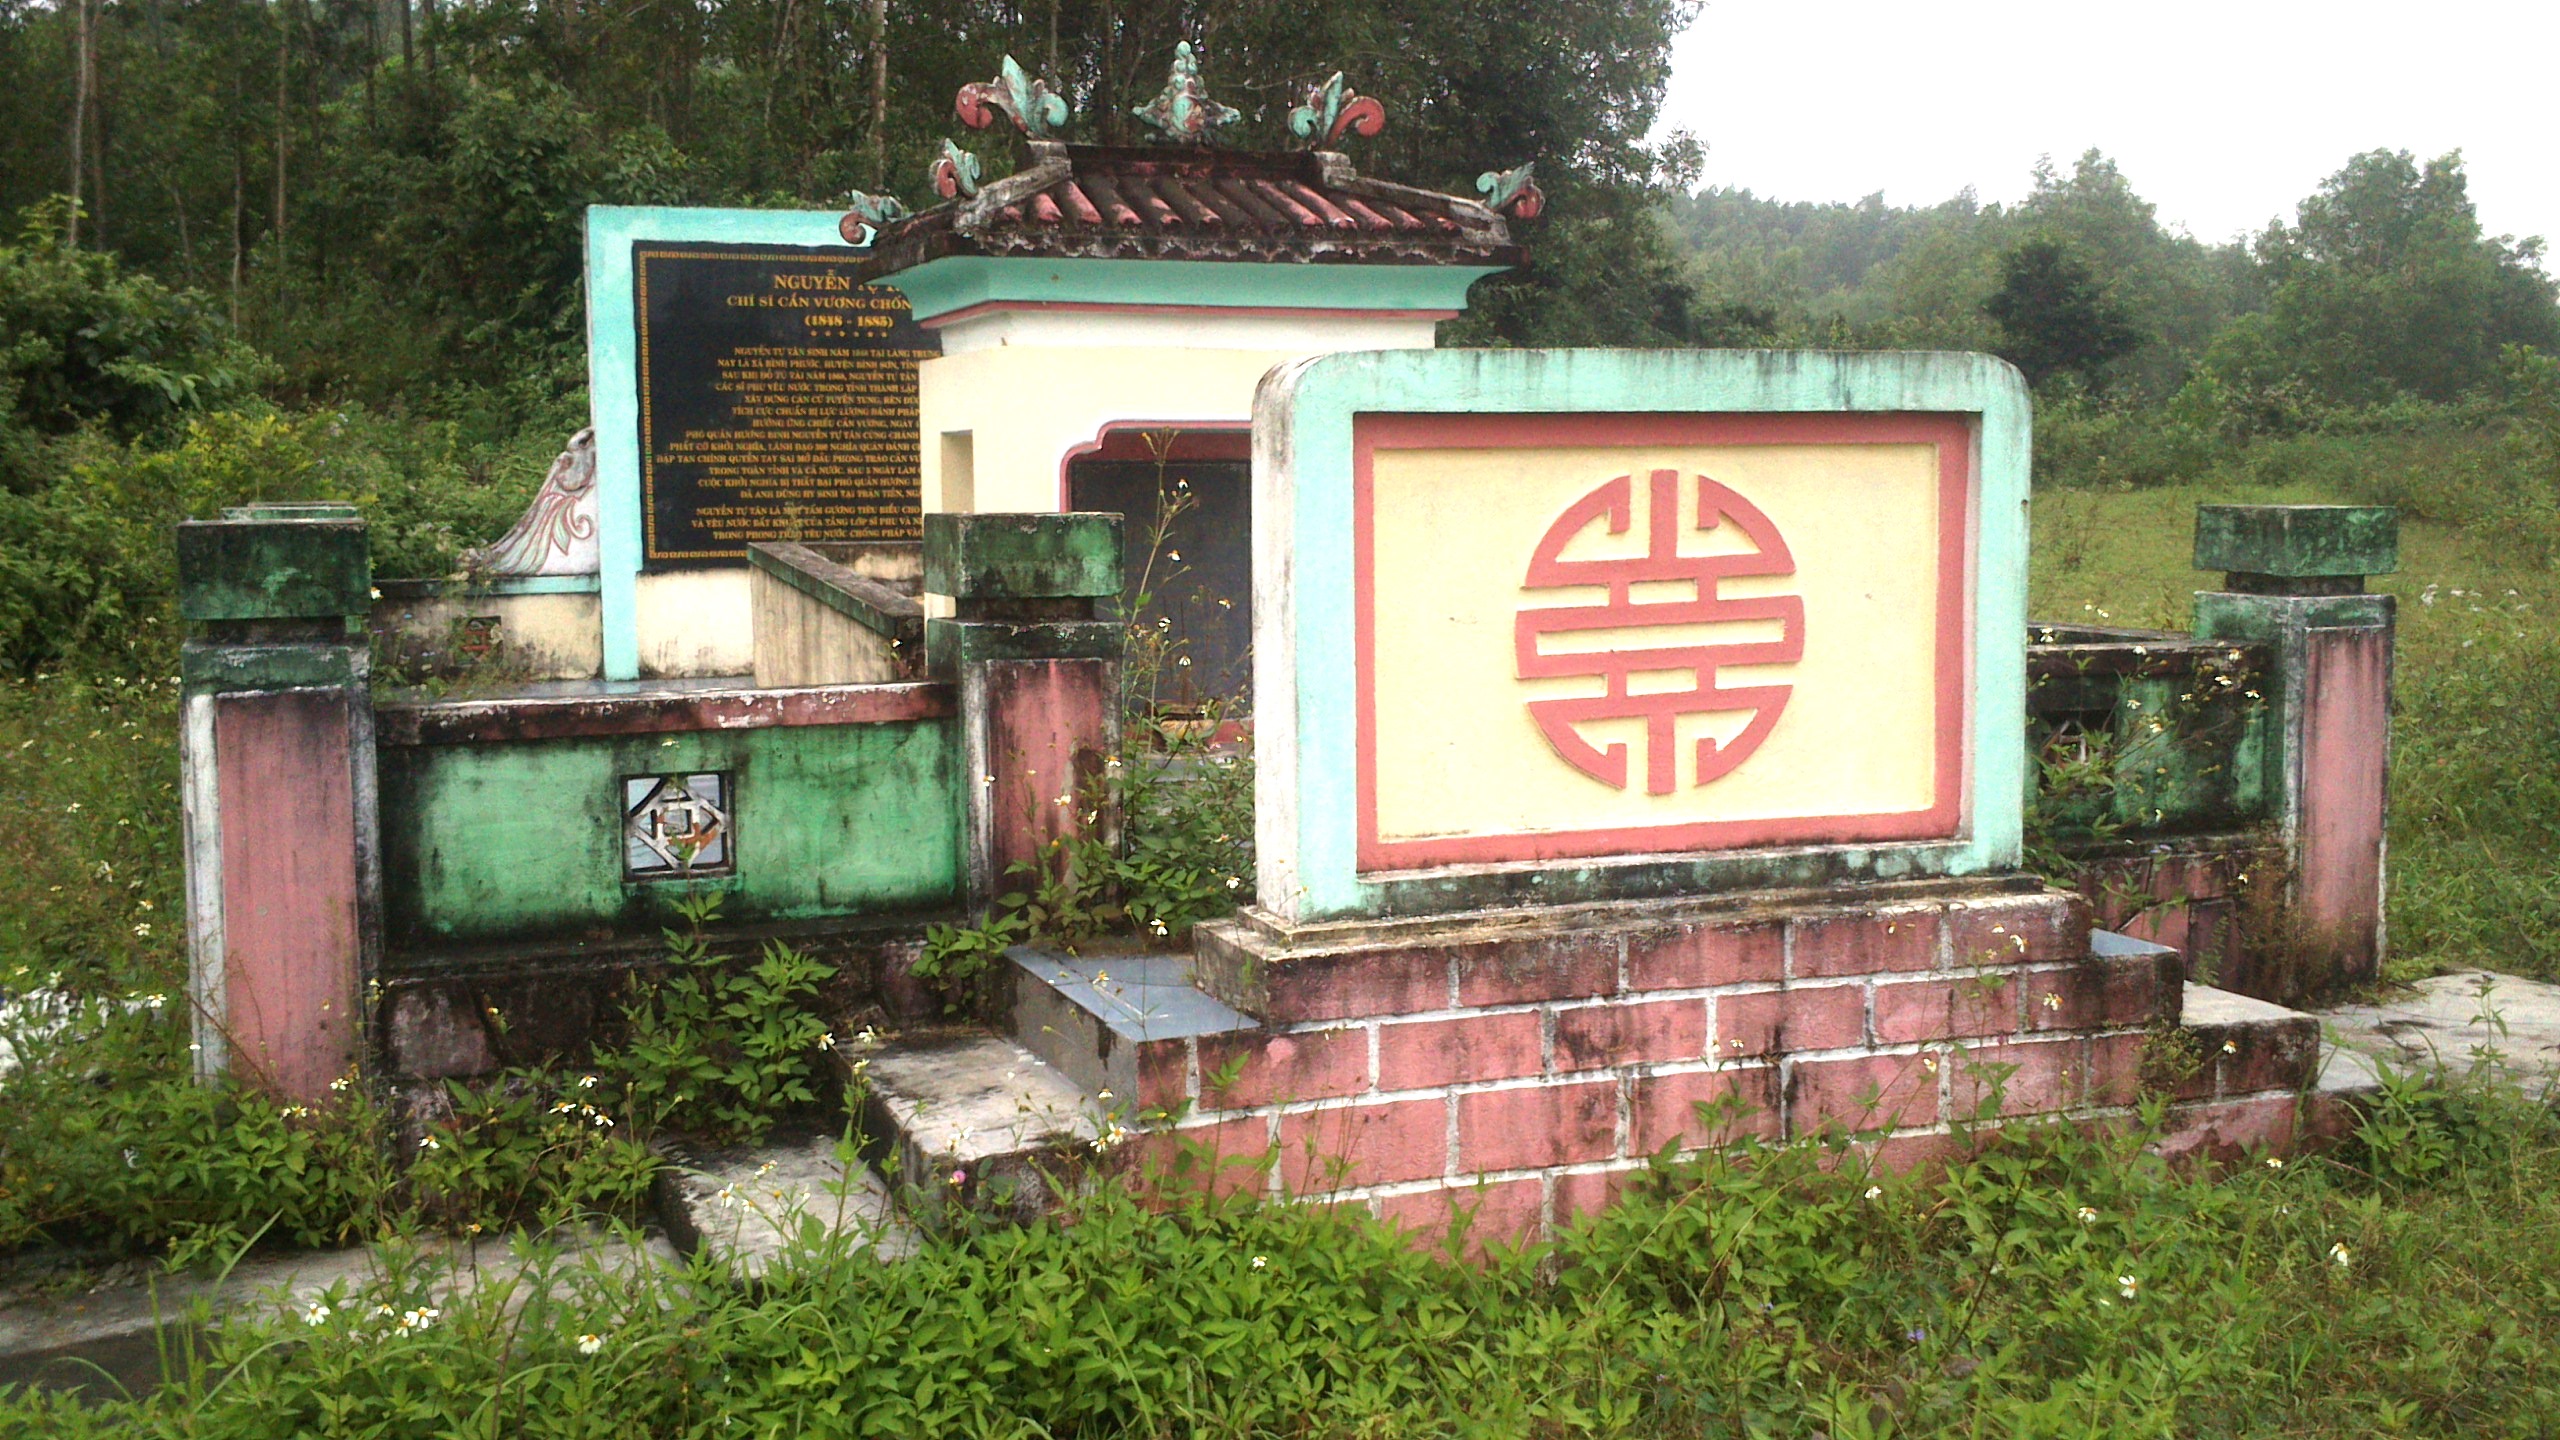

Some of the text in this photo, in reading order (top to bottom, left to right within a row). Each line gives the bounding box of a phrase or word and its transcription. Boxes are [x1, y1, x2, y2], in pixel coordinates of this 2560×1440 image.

[774, 269, 850, 290] NGUYỄN
[727, 294, 754, 306] CHÍ
[814, 296, 866, 309] VƯƠNG
[870, 294, 912, 310] CHỐN
[857, 316, 894, 328] 1885)
